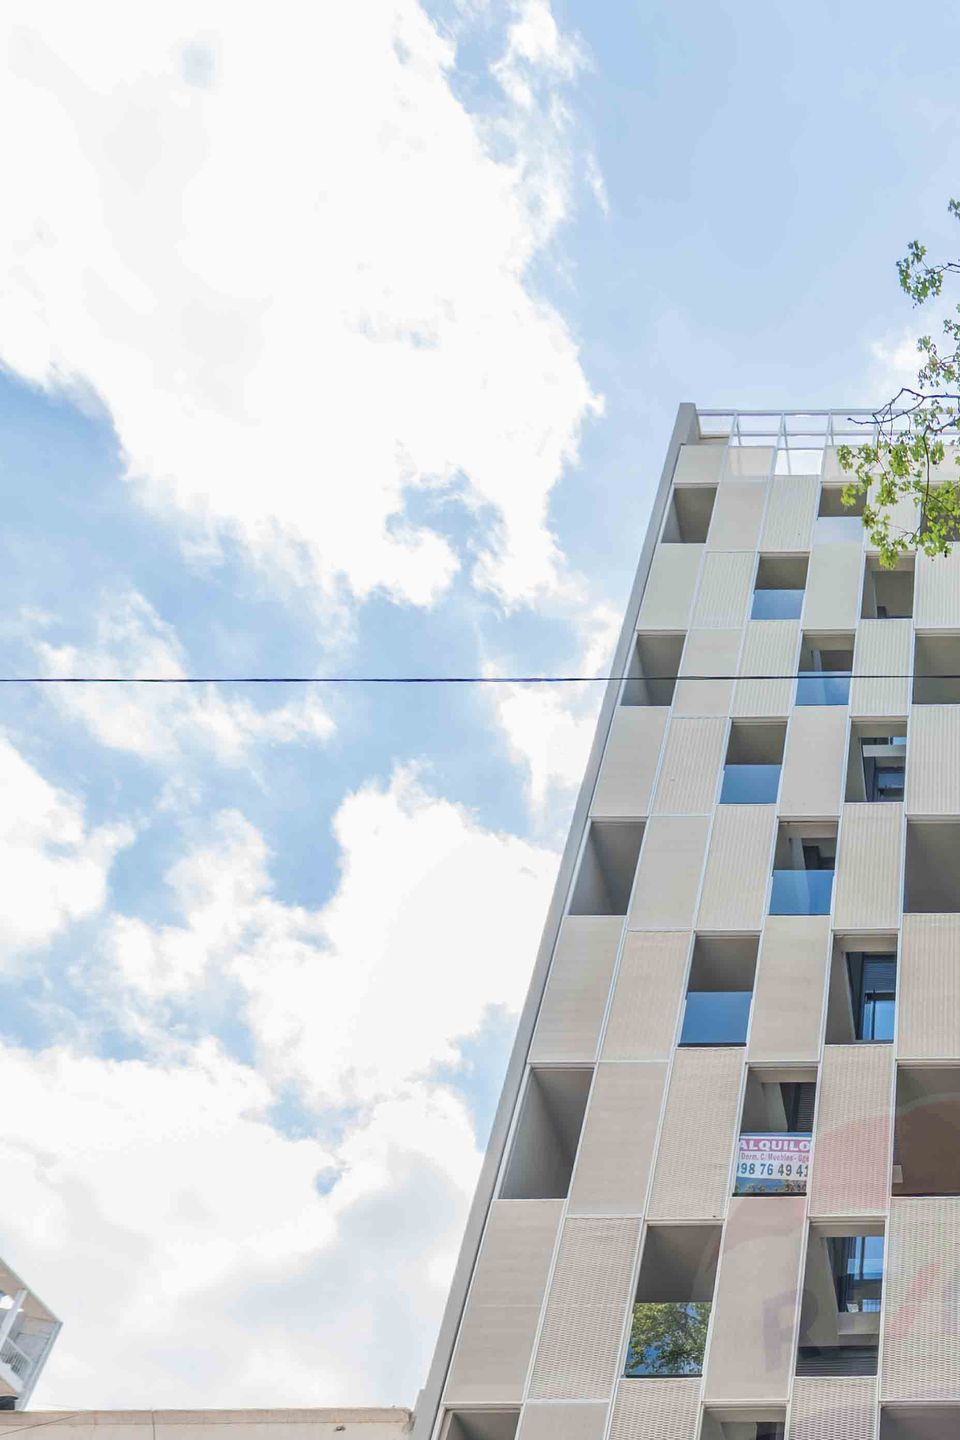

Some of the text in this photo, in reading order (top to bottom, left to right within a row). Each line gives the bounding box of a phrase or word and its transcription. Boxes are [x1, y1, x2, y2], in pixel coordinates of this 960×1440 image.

[739, 1140, 810, 1153] ALQUILO
[760, 1163, 774, 1176] 76
[778, 1163, 792, 1177] 49
